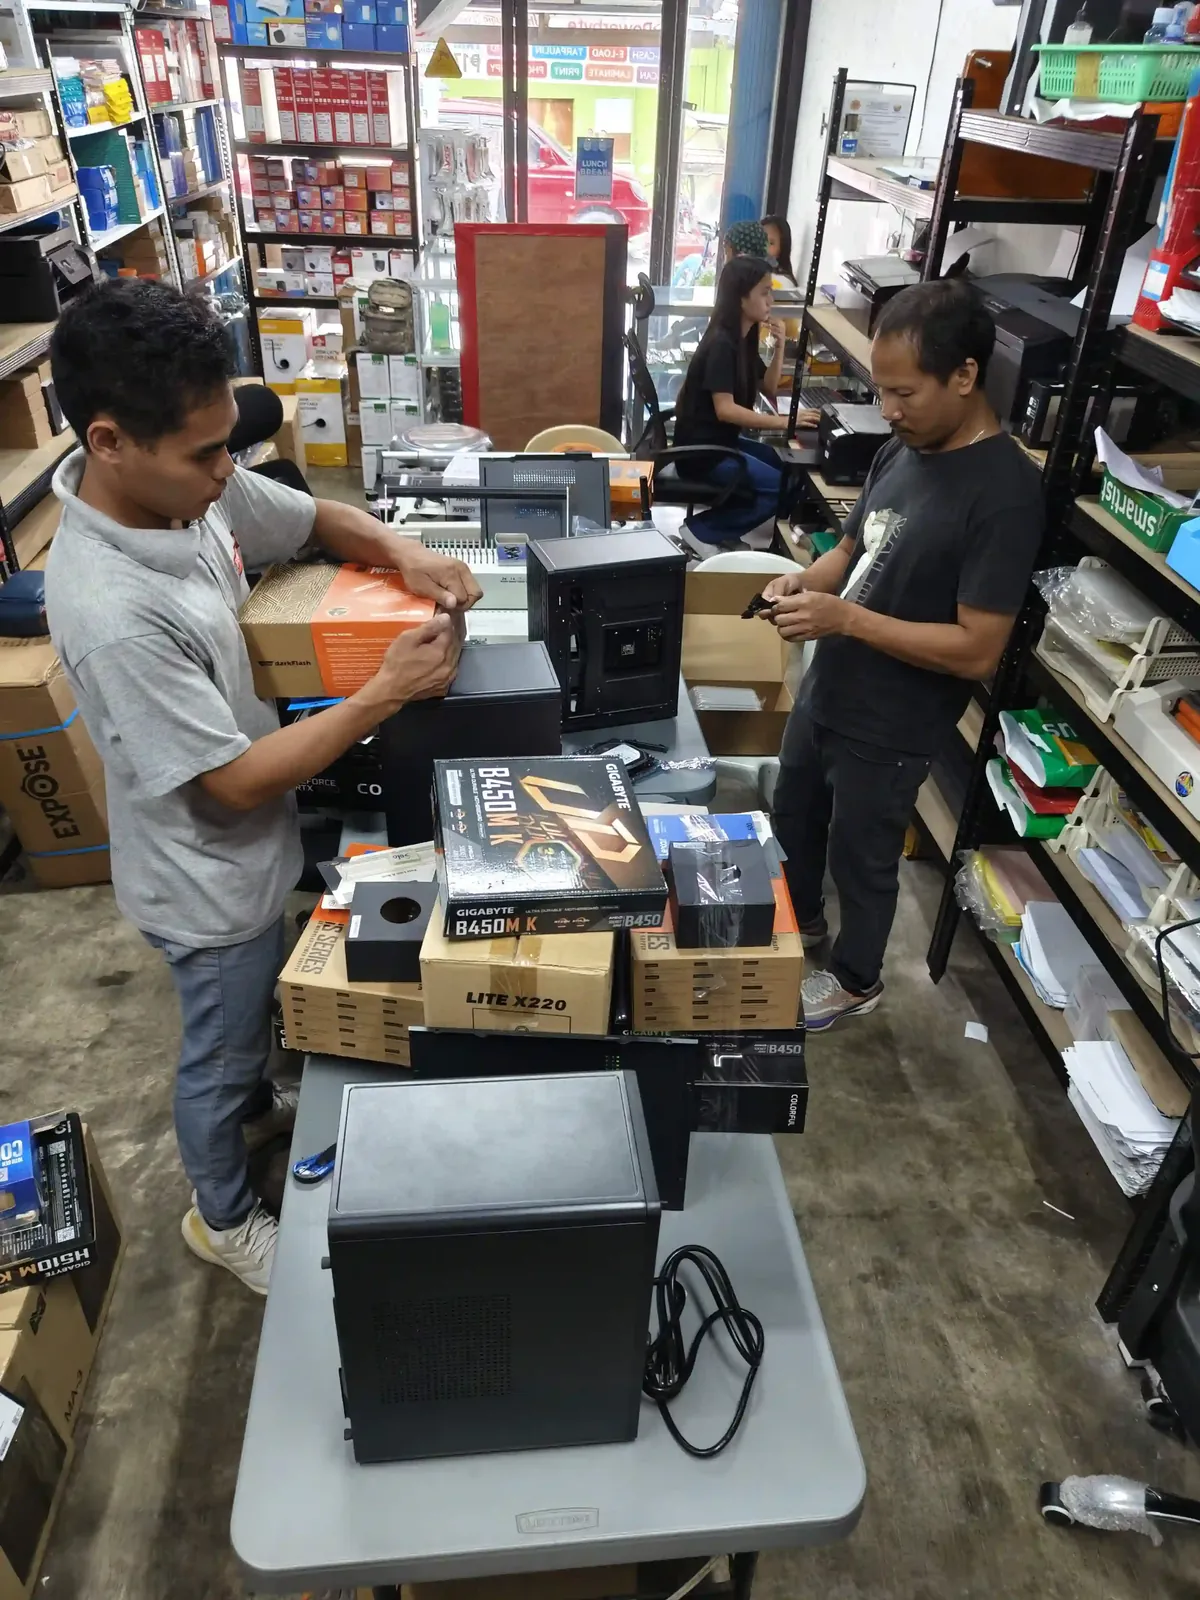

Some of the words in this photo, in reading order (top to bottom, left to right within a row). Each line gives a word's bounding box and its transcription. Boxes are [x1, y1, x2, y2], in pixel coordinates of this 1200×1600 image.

[1101, 476, 1157, 537] smartist
[17, 745, 81, 839] EXPOSE
[478, 767, 520, 826] B450M
[605, 763, 630, 809] GIGABYTE
[489, 834, 524, 846] K
[456, 906, 515, 917] GIGABYTE
[625, 913, 662, 927] B450
[456, 917, 520, 937] B450M
[526, 916, 538, 932] K
[301, 934, 338, 975] SERIES
[465, 992, 508, 1006] LITE
[513, 995, 567, 1011] X220
[622, 1029, 671, 1037] GIGABYTE
[769, 1044, 802, 1054] B450
[787, 1093, 799, 1126] COLORFUL
[18, 1247, 90, 1277] H510M
[45, 1260, 91, 1278] GIGABYTE
